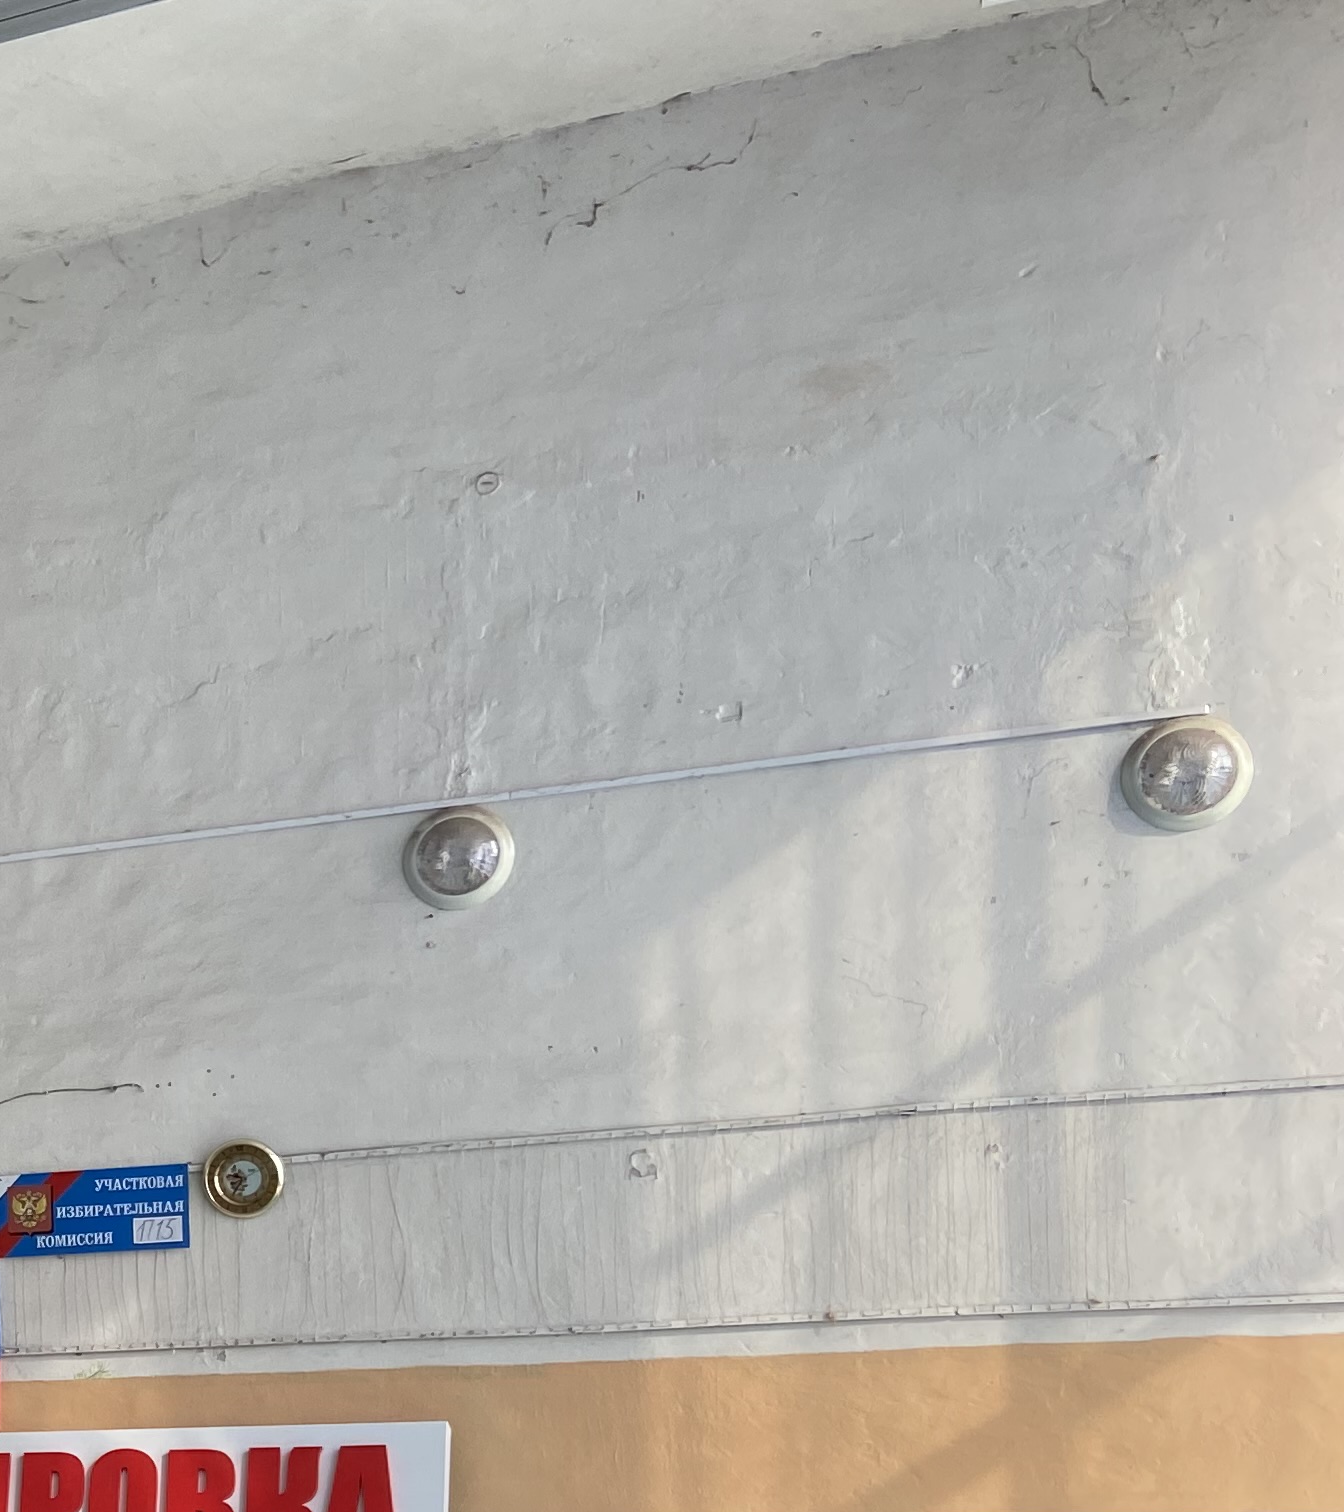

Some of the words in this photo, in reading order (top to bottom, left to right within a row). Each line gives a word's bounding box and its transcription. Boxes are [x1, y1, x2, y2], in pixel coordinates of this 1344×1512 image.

[95, 1175, 184, 1191] УЧАСТКОВАЯ
[56, 1200, 184, 1218] ИЗБИРАТЕЛЬНАЯ
[137, 1218, 178, 1241] 1715
[37, 1232, 113, 1248] КОМИССИЯ
